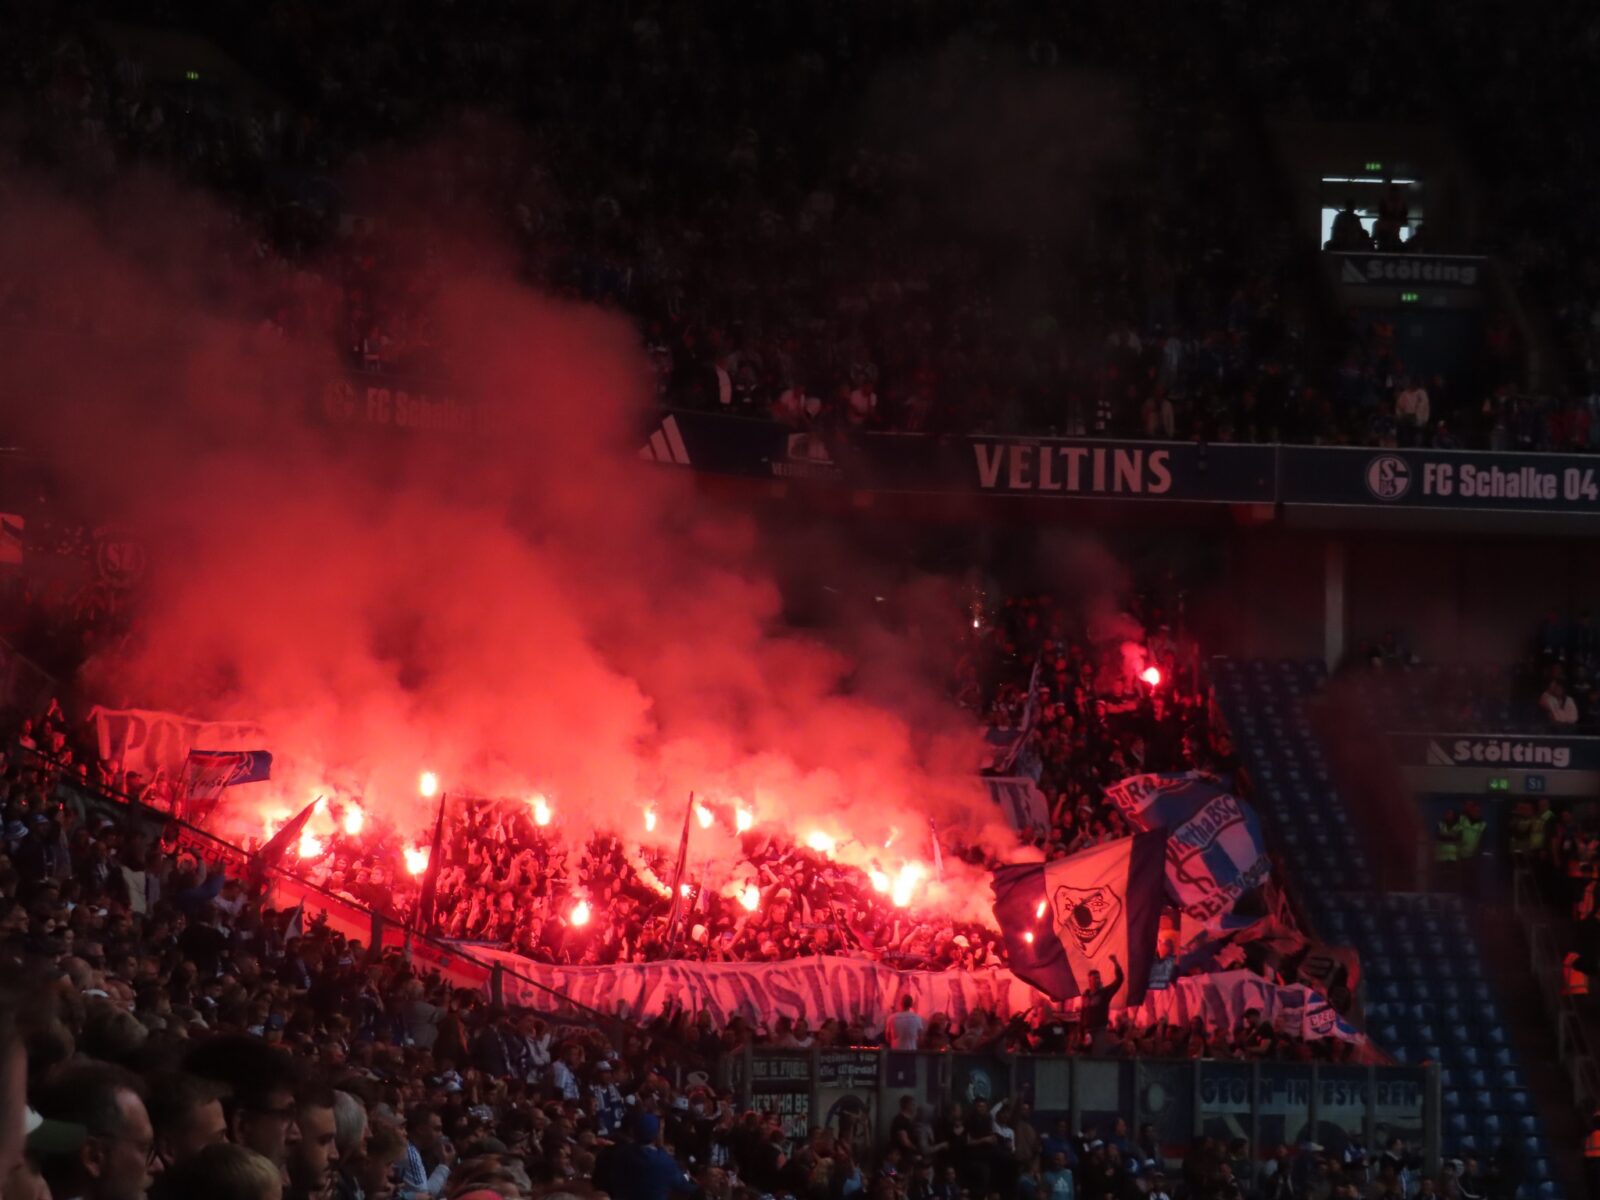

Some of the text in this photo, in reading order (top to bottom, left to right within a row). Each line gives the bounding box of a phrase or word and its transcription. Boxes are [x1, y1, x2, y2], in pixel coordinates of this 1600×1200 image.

[1366, 259, 1477, 285] Stölting
[973, 443, 1172, 494] VELTINS
[1423, 462, 1597, 500] FC Schalke 04
[1453, 739, 1570, 768] Stölting
[1287, 1078, 1417, 1107] INESTOREN
